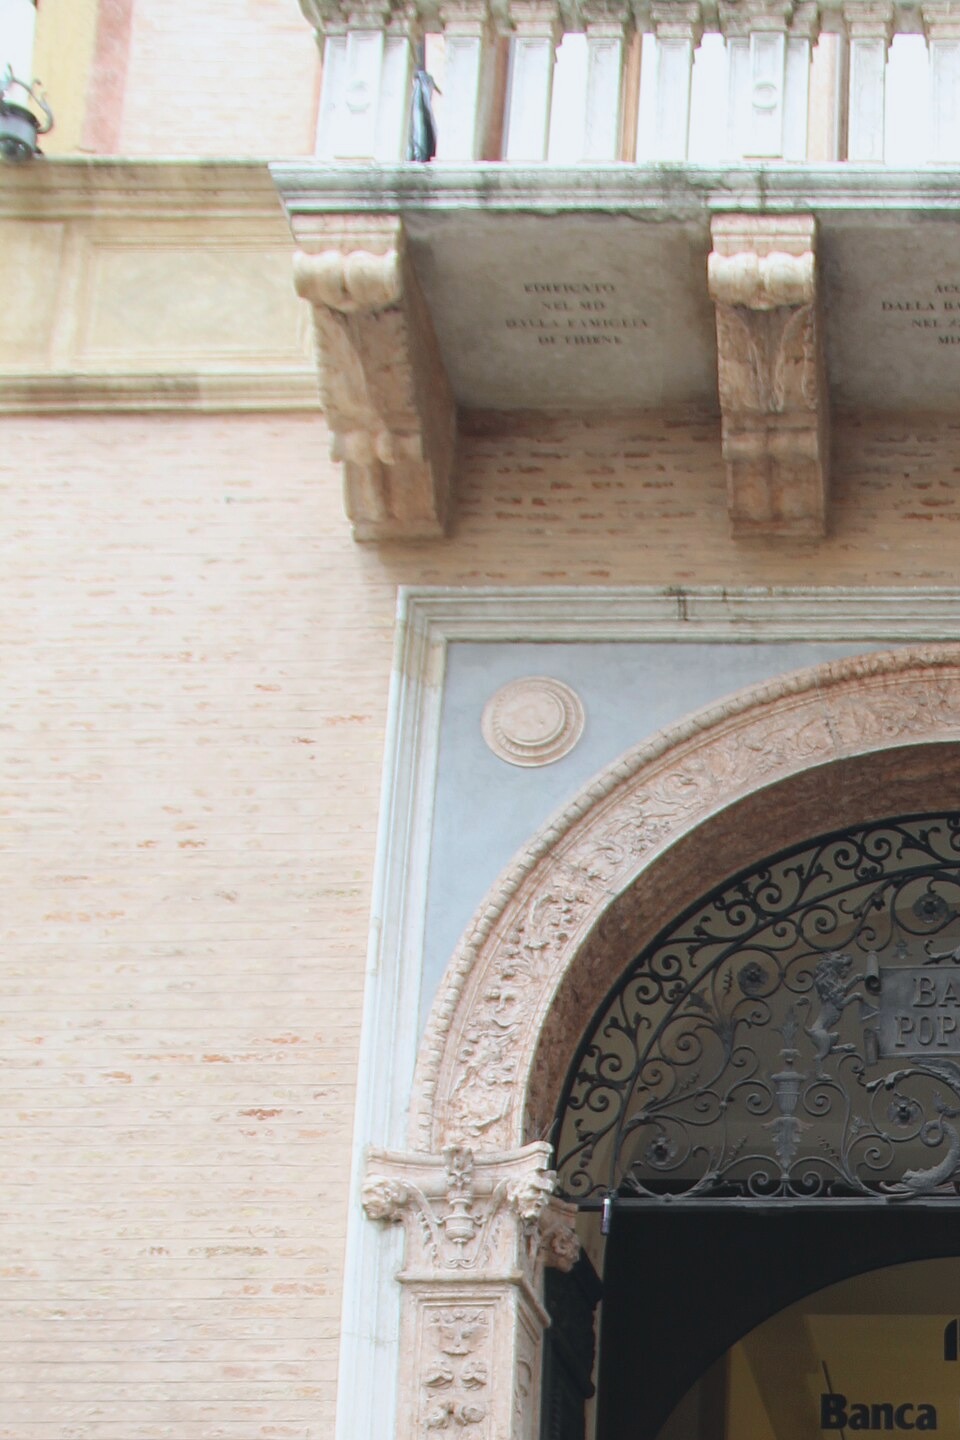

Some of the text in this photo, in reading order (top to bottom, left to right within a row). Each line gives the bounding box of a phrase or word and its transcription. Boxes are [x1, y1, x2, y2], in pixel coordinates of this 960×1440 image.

[524, 282, 615, 293] EDIFICATO
[543, 301, 571, 310] NEL
[881, 301, 935, 311] DALLA
[505, 318, 649, 329] DALLA FAMIGLIA
[911, 318, 939, 328] NEL
[538, 335, 556, 345] DI
[819, 1393, 938, 1430] Banca
